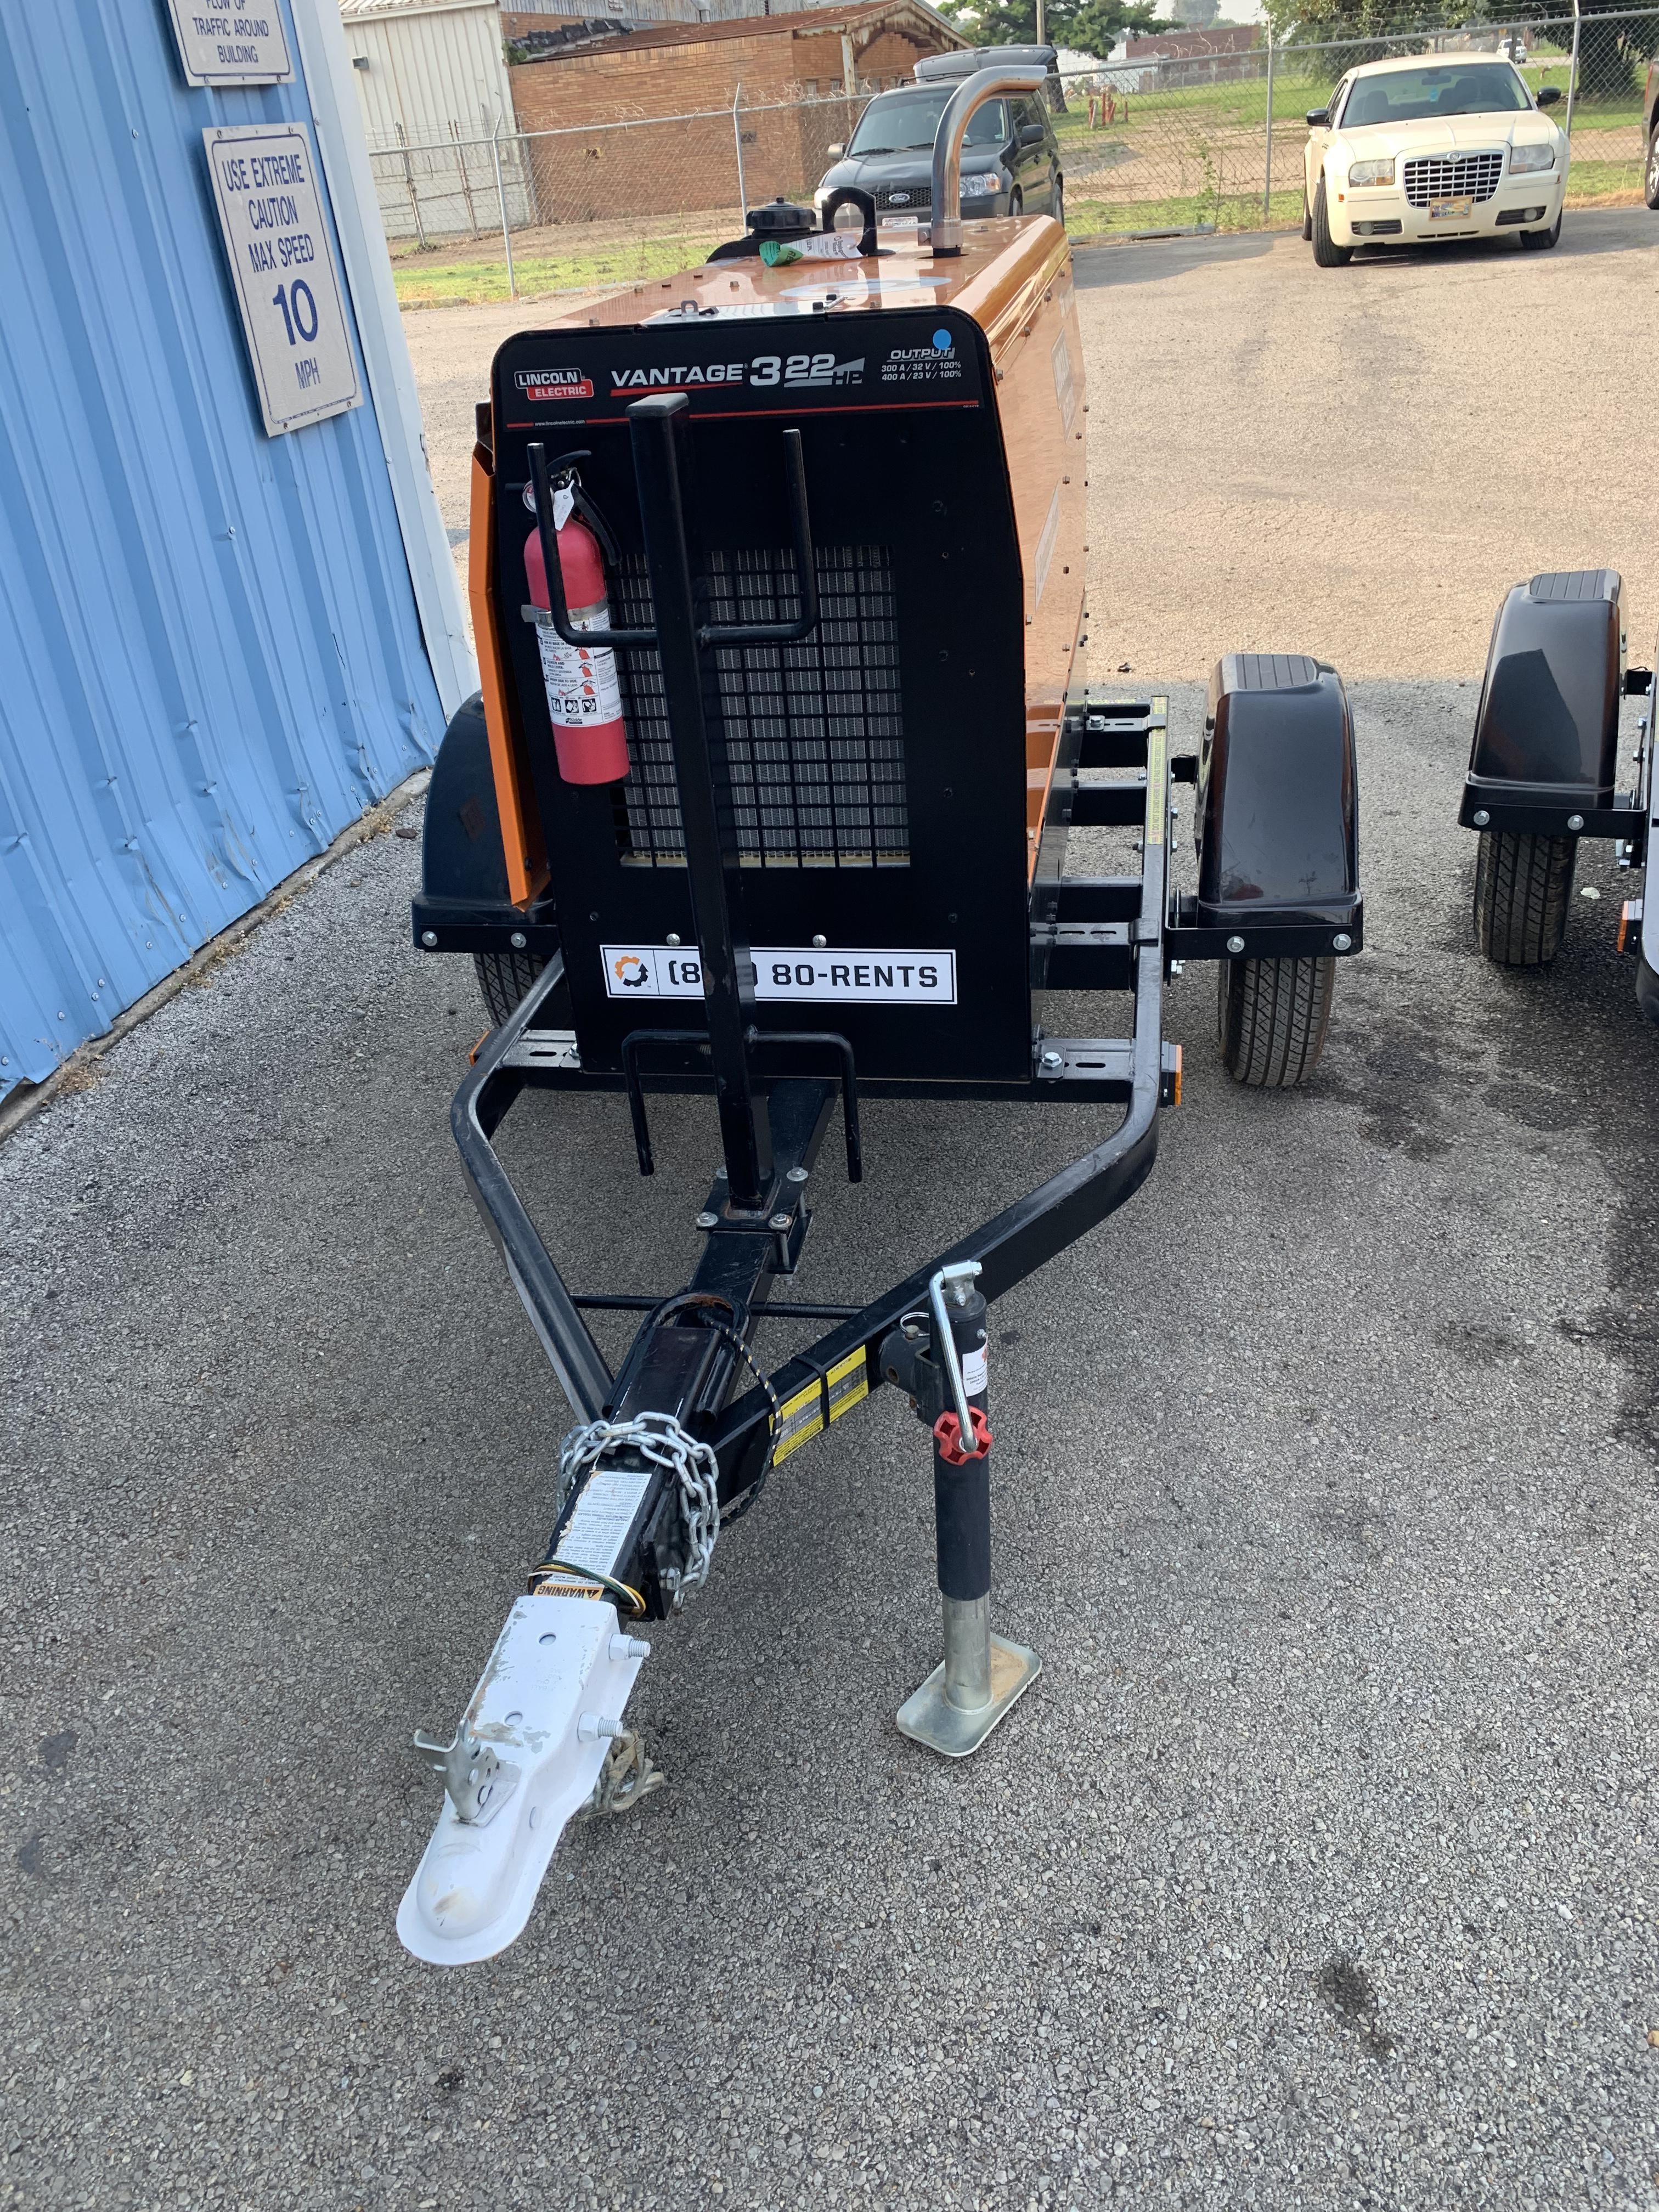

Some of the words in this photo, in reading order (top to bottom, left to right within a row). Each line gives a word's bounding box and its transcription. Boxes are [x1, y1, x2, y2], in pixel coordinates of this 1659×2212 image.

[193, 17, 230, 36] TRAFFIC
[234, 19, 269, 37] AROUND
[217, 45, 258, 63] BUILDING
[222, 159, 250, 191] USE
[250, 154, 305, 188] EXTREME
[249, 195, 299, 230] CAUTION
[248, 240, 277, 273] MAX
[278, 233, 314, 268] SPEED
[272, 279, 318, 346] 10
[890, 347, 951, 360] OUTPUT
[295, 357, 321, 390] MPH
[611, 363, 744, 387] VANTAGE
[749, 353, 836, 386] 322
[939, 361, 961, 369] 100%
[518, 371, 578, 386] LINCOLN
[534, 386, 586, 397] ELECTRIC
[772, 964, 938, 988] 80-RENTS
[538, 1585, 586, 1598] WARNING
